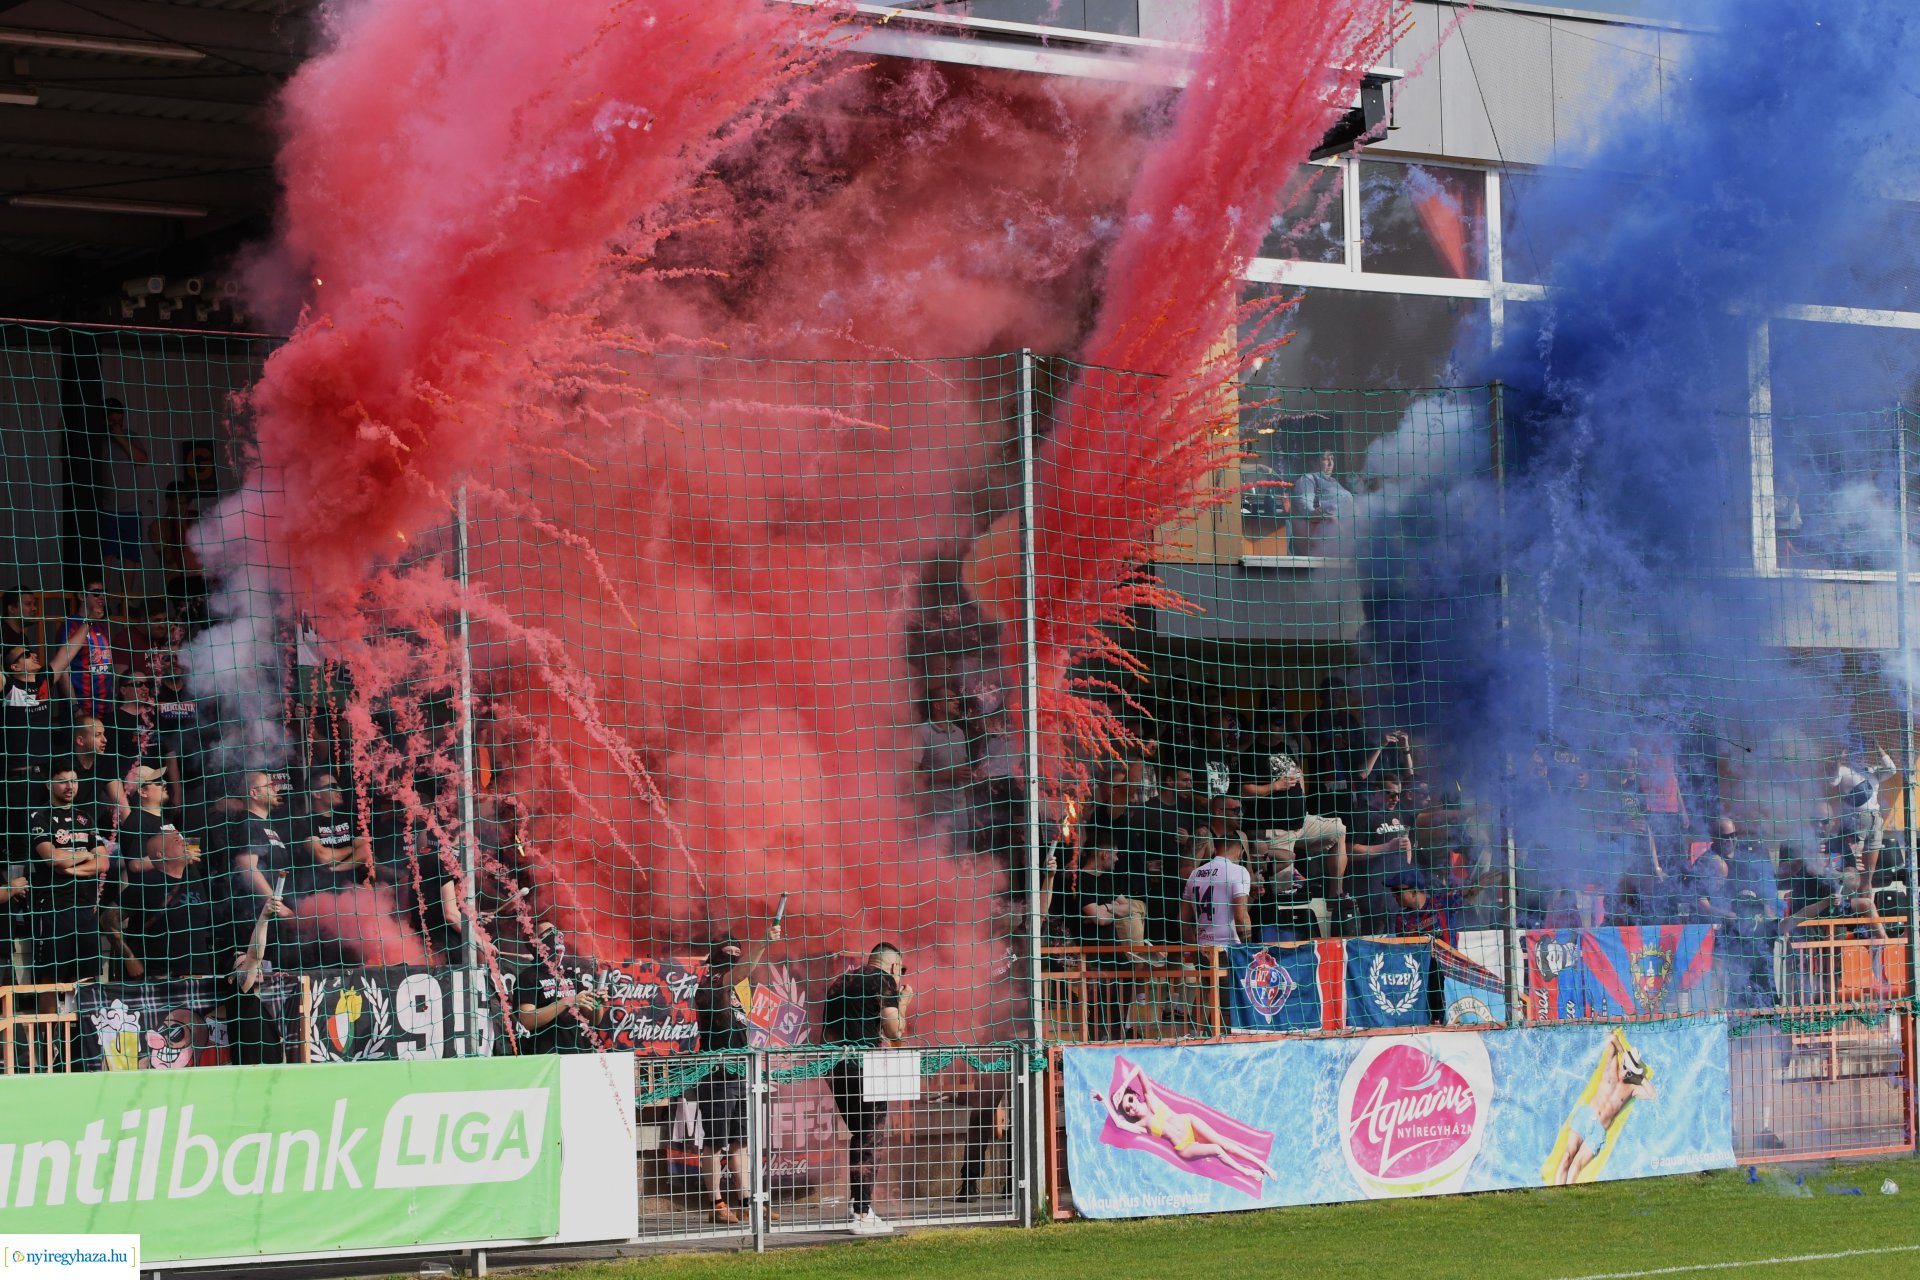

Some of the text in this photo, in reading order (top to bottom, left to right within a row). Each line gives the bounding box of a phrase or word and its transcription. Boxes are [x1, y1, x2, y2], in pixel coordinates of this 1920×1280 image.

[1380, 972, 1412, 987] 1928
[396, 1109, 531, 1167] LIGA
[1350, 1077, 1475, 1178] Aquarius
